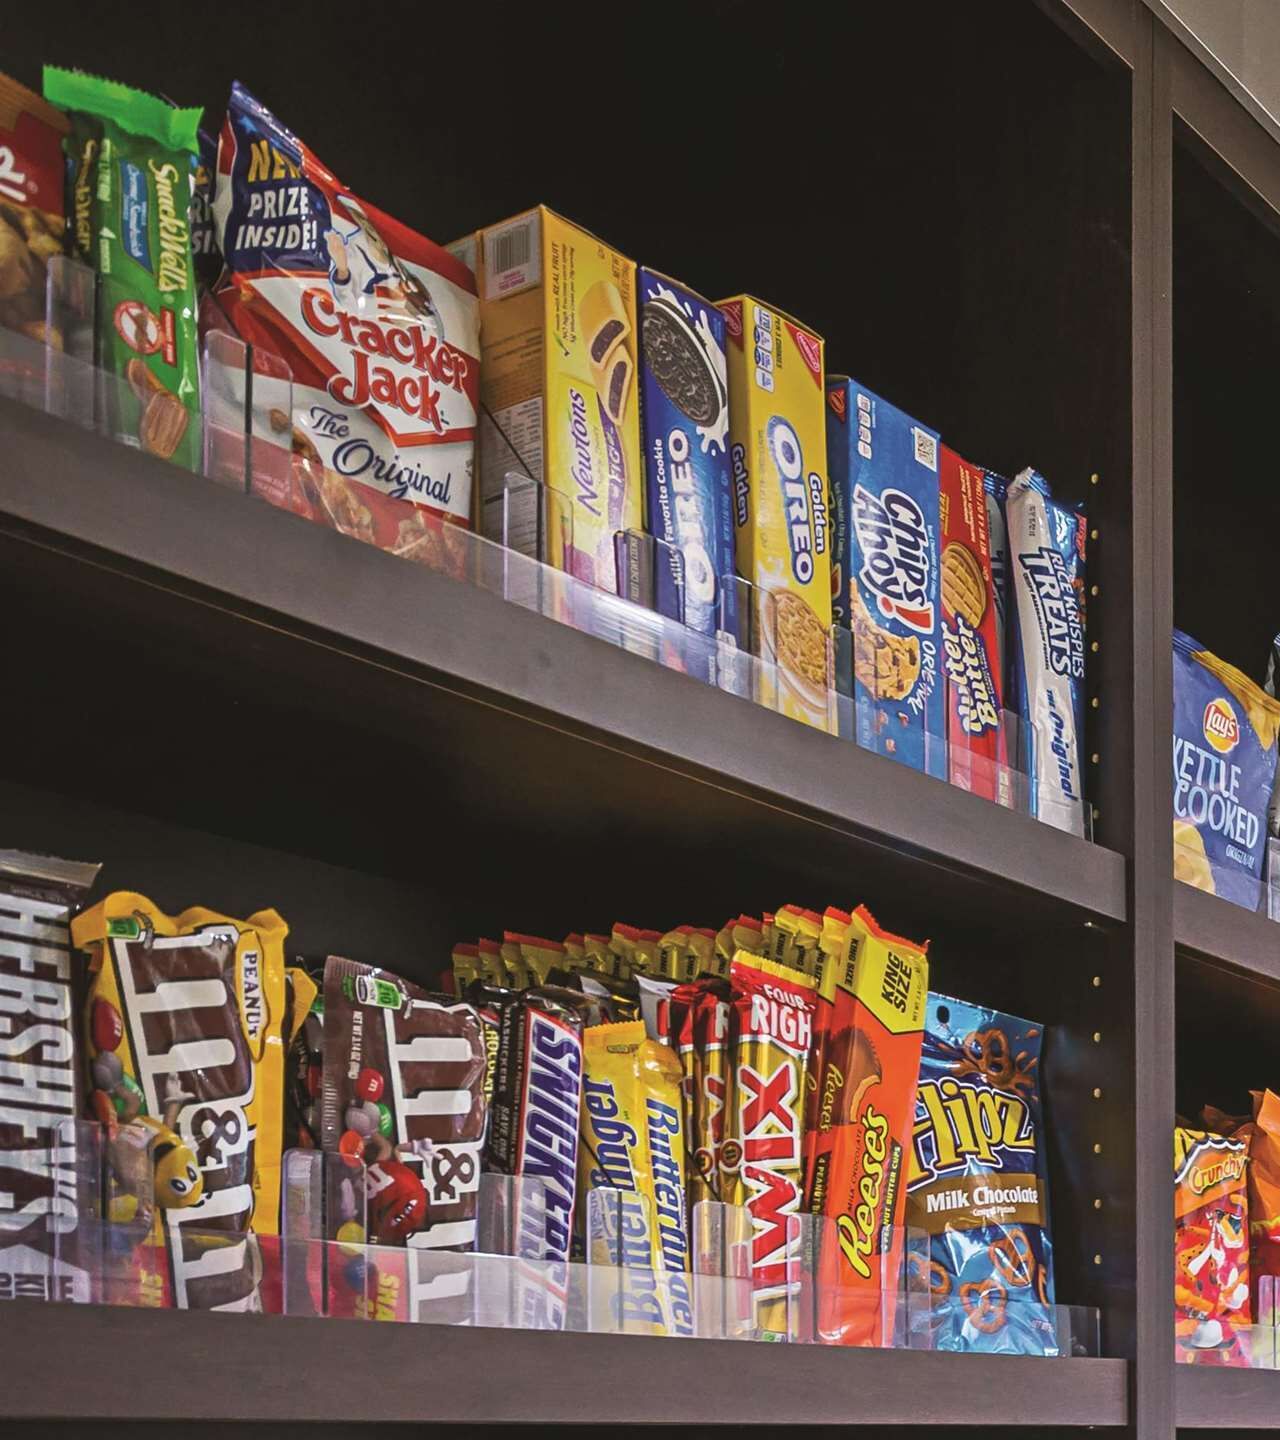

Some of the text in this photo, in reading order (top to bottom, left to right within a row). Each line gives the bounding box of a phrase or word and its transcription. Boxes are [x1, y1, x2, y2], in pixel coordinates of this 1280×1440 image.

[148, 159, 188, 291] SnackWell's
[235, 222, 318, 252] INSIDE!
[247, 186, 311, 221] PRIZE
[552, 242, 566, 296] REAL FRUIT
[301, 286, 469, 391] Cracker
[309, 405, 349, 439] The
[327, 350, 445, 432] Jack
[331, 438, 452, 504] Original
[569, 388, 602, 517] Newtons
[653, 438, 666, 486] Cookie
[731, 443, 749, 526] Golden
[659, 483, 675, 542] Favorite
[668, 428, 715, 603] OREO
[772, 420, 814, 583] OREO
[808, 472, 825, 555] Golden
[853, 483, 934, 634] Ahoy!
[882, 489, 931, 608] Chips
[1048, 552, 1073, 594] RICE
[1019, 547, 1072, 678] TREATS
[1058, 593, 1085, 680] KRISPIES
[940, 620, 983, 735] Nutter
[955, 615, 999, 728] Butter
[1045, 688, 1078, 804] THE Original
[1205, 703, 1239, 742] Lay's
[1173, 779, 1259, 850] COOKED
[1226, 842, 1256, 870] ORIGINAL
[240, 951, 268, 1038] PEANUT
[763, 984, 805, 1009] FOUR
[844, 938, 857, 987] KING SIZE
[880, 951, 901, 1003] KING
[891, 961, 912, 1014] SIZE
[0, 892, 77, 1235] HERSHEY'S
[820, 1063, 844, 1134] Reese's
[736, 1062, 804, 1296] TWIX
[836, 1104, 890, 1280] Reese's
[886, 1172, 899, 1208] BUTTER
[892, 1147, 902, 1171] CUPS
[1190, 1155, 1248, 1195] Crunchy
[926, 1185, 1039, 1213] Milk Chocolate
